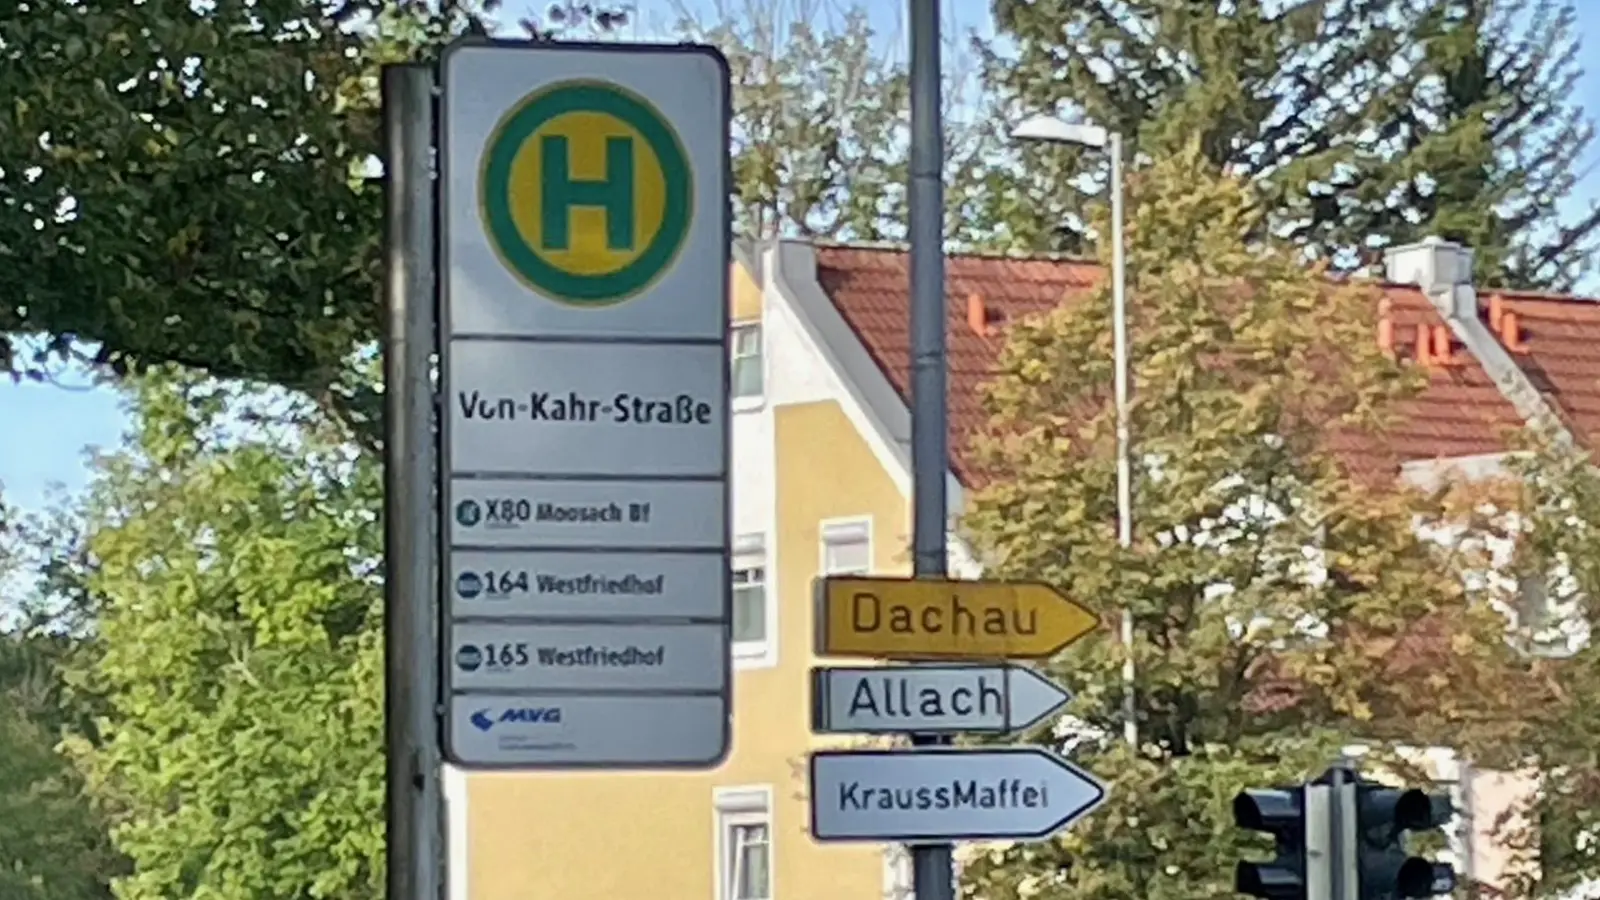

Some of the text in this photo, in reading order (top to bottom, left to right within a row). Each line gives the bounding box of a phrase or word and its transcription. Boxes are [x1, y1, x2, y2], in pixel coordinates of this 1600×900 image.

[485, 499, 530, 521] X80
[536, 503, 622, 522] Moosach
[485, 571, 529, 594] 164
[537, 574, 664, 595] Westfriedhof
[852, 593, 1036, 636] Dachau
[485, 643, 529, 666] 165
[537, 646, 664, 666] Westfriedhof
[849, 676, 1002, 717] Allach
[499, 707, 561, 723] MVG
[839, 779, 1048, 811] KraussMaffei
